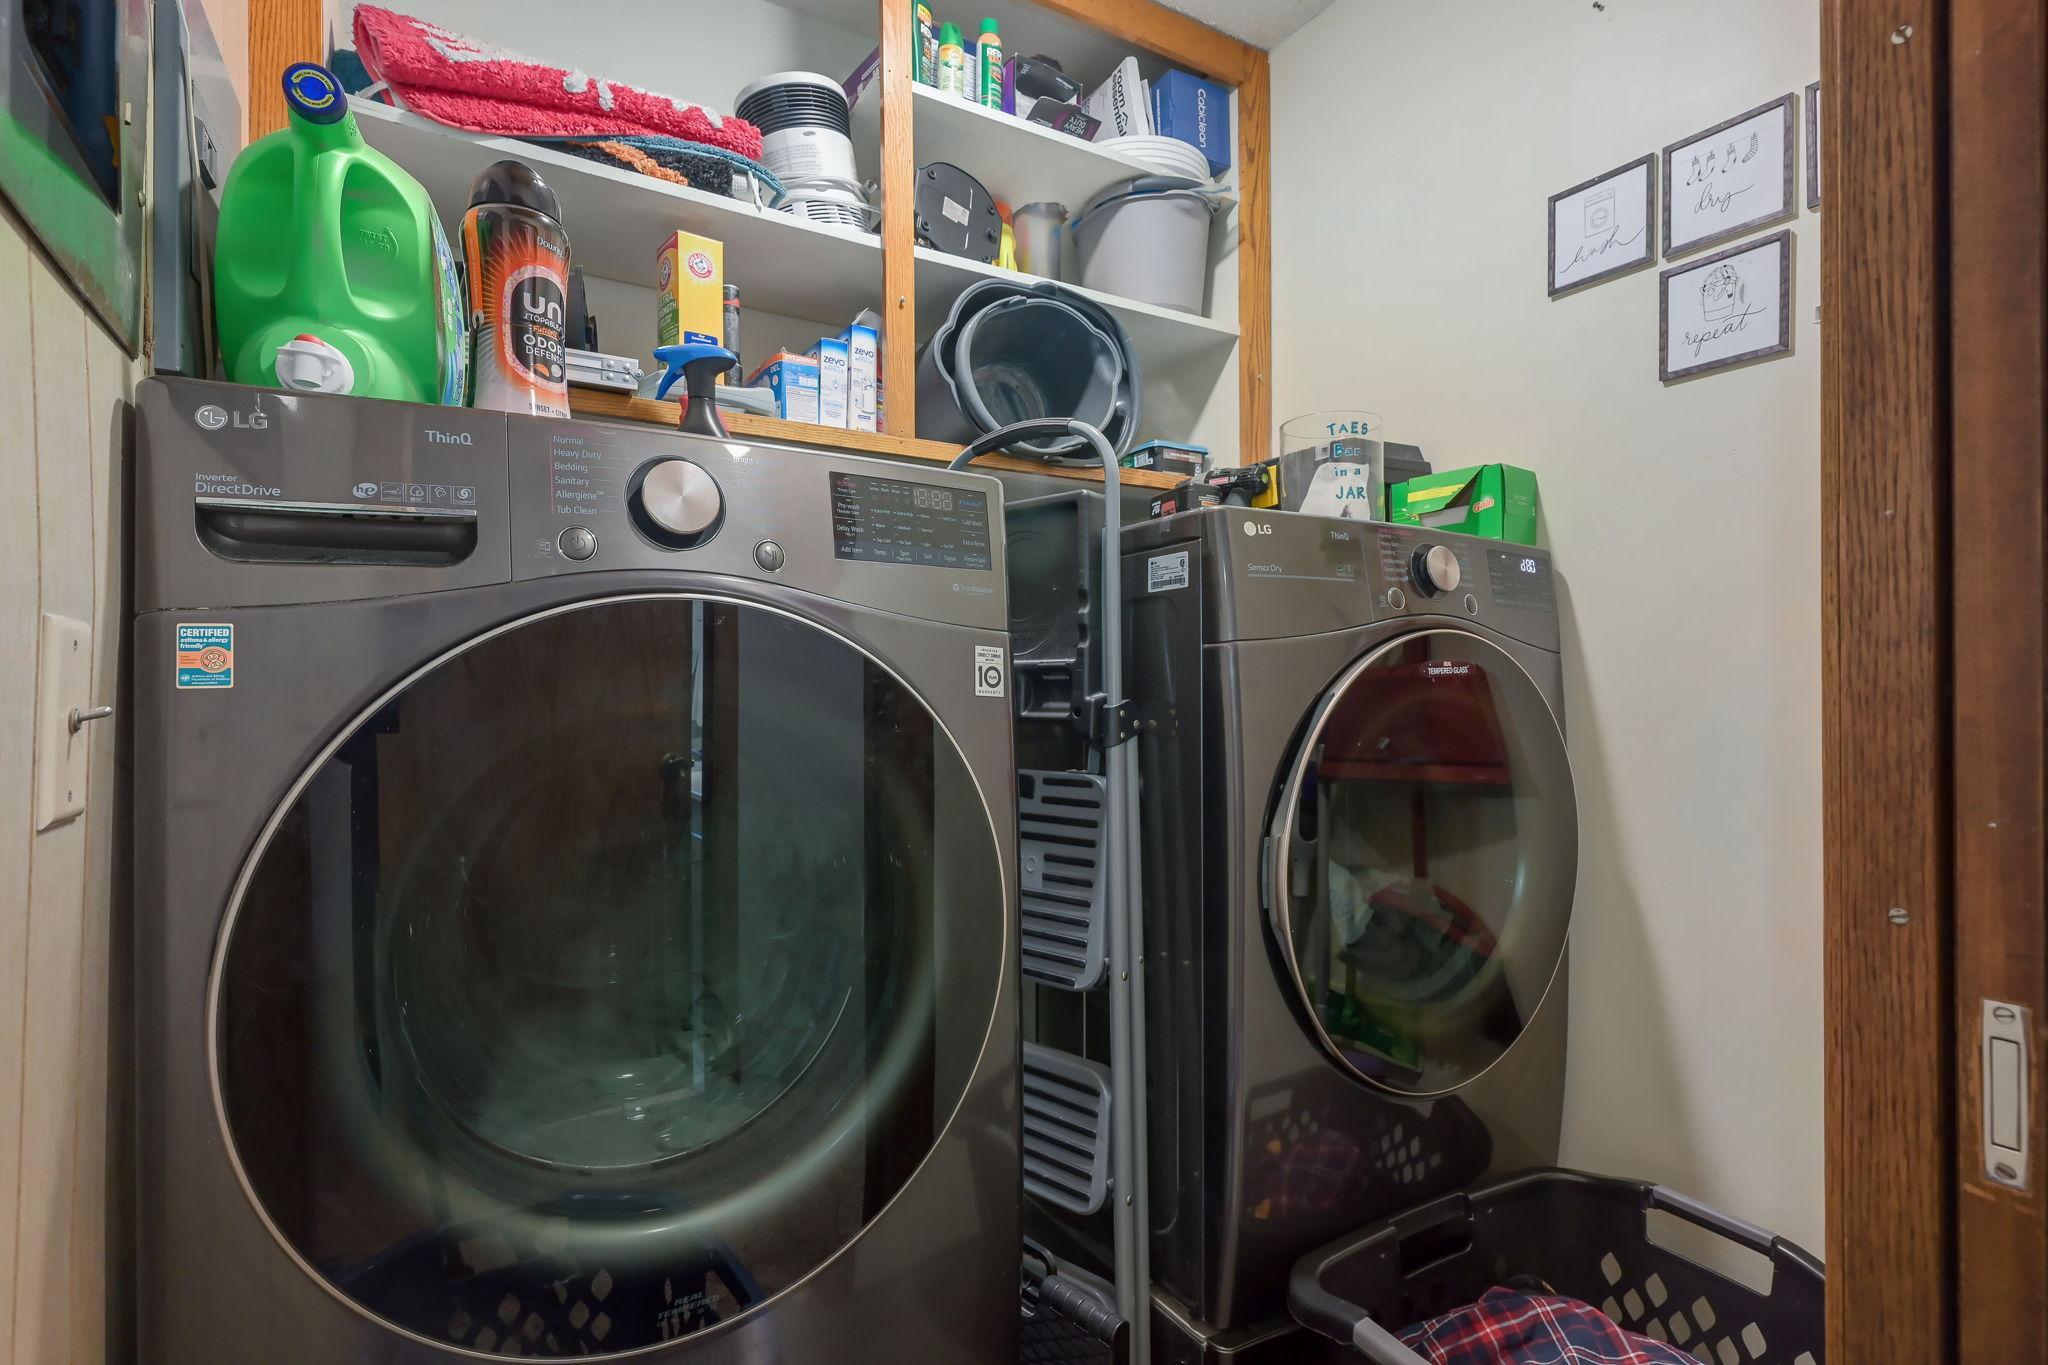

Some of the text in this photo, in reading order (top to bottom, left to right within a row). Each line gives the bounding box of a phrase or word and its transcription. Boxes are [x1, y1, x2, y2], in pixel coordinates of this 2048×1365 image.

[1118, 68, 1126, 108] room
[1112, 74, 1127, 137] essential
[1069, 116, 1086, 128] DUTY
[1064, 122, 1084, 136] HEAVY
[1694, 182, 1754, 214] dry
[536, 236, 564, 258] Downy
[1682, 303, 1768, 357] repeat
[523, 334, 562, 356] ODOR
[526, 346, 564, 366] DEFENSE
[854, 347, 875, 358] zevo
[824, 355, 845, 367] zevo
[233, 411, 268, 429] LG
[1326, 421, 1369, 436] TAES
[424, 430, 473, 445] ThinQ
[553, 435, 584, 445] Normal
[554, 449, 602, 461] Heavy Duty
[732, 456, 754, 465] Bright
[554, 462, 588, 474] Bedding
[1334, 466, 1348, 477] in
[195, 473, 238, 481] Inverter
[554, 476, 590, 487] Sanitary
[1336, 486, 1366, 500] JAR
[557, 505, 597, 515] Tub Clean
[1472, 498, 1494, 513] Gain
[1258, 524, 1272, 535] LG
[1329, 531, 1349, 541] ThinQ
[944, 554, 956, 563] Signal
[180, 628, 229, 637] CERTIFIED
[978, 666, 1001, 688] 10
